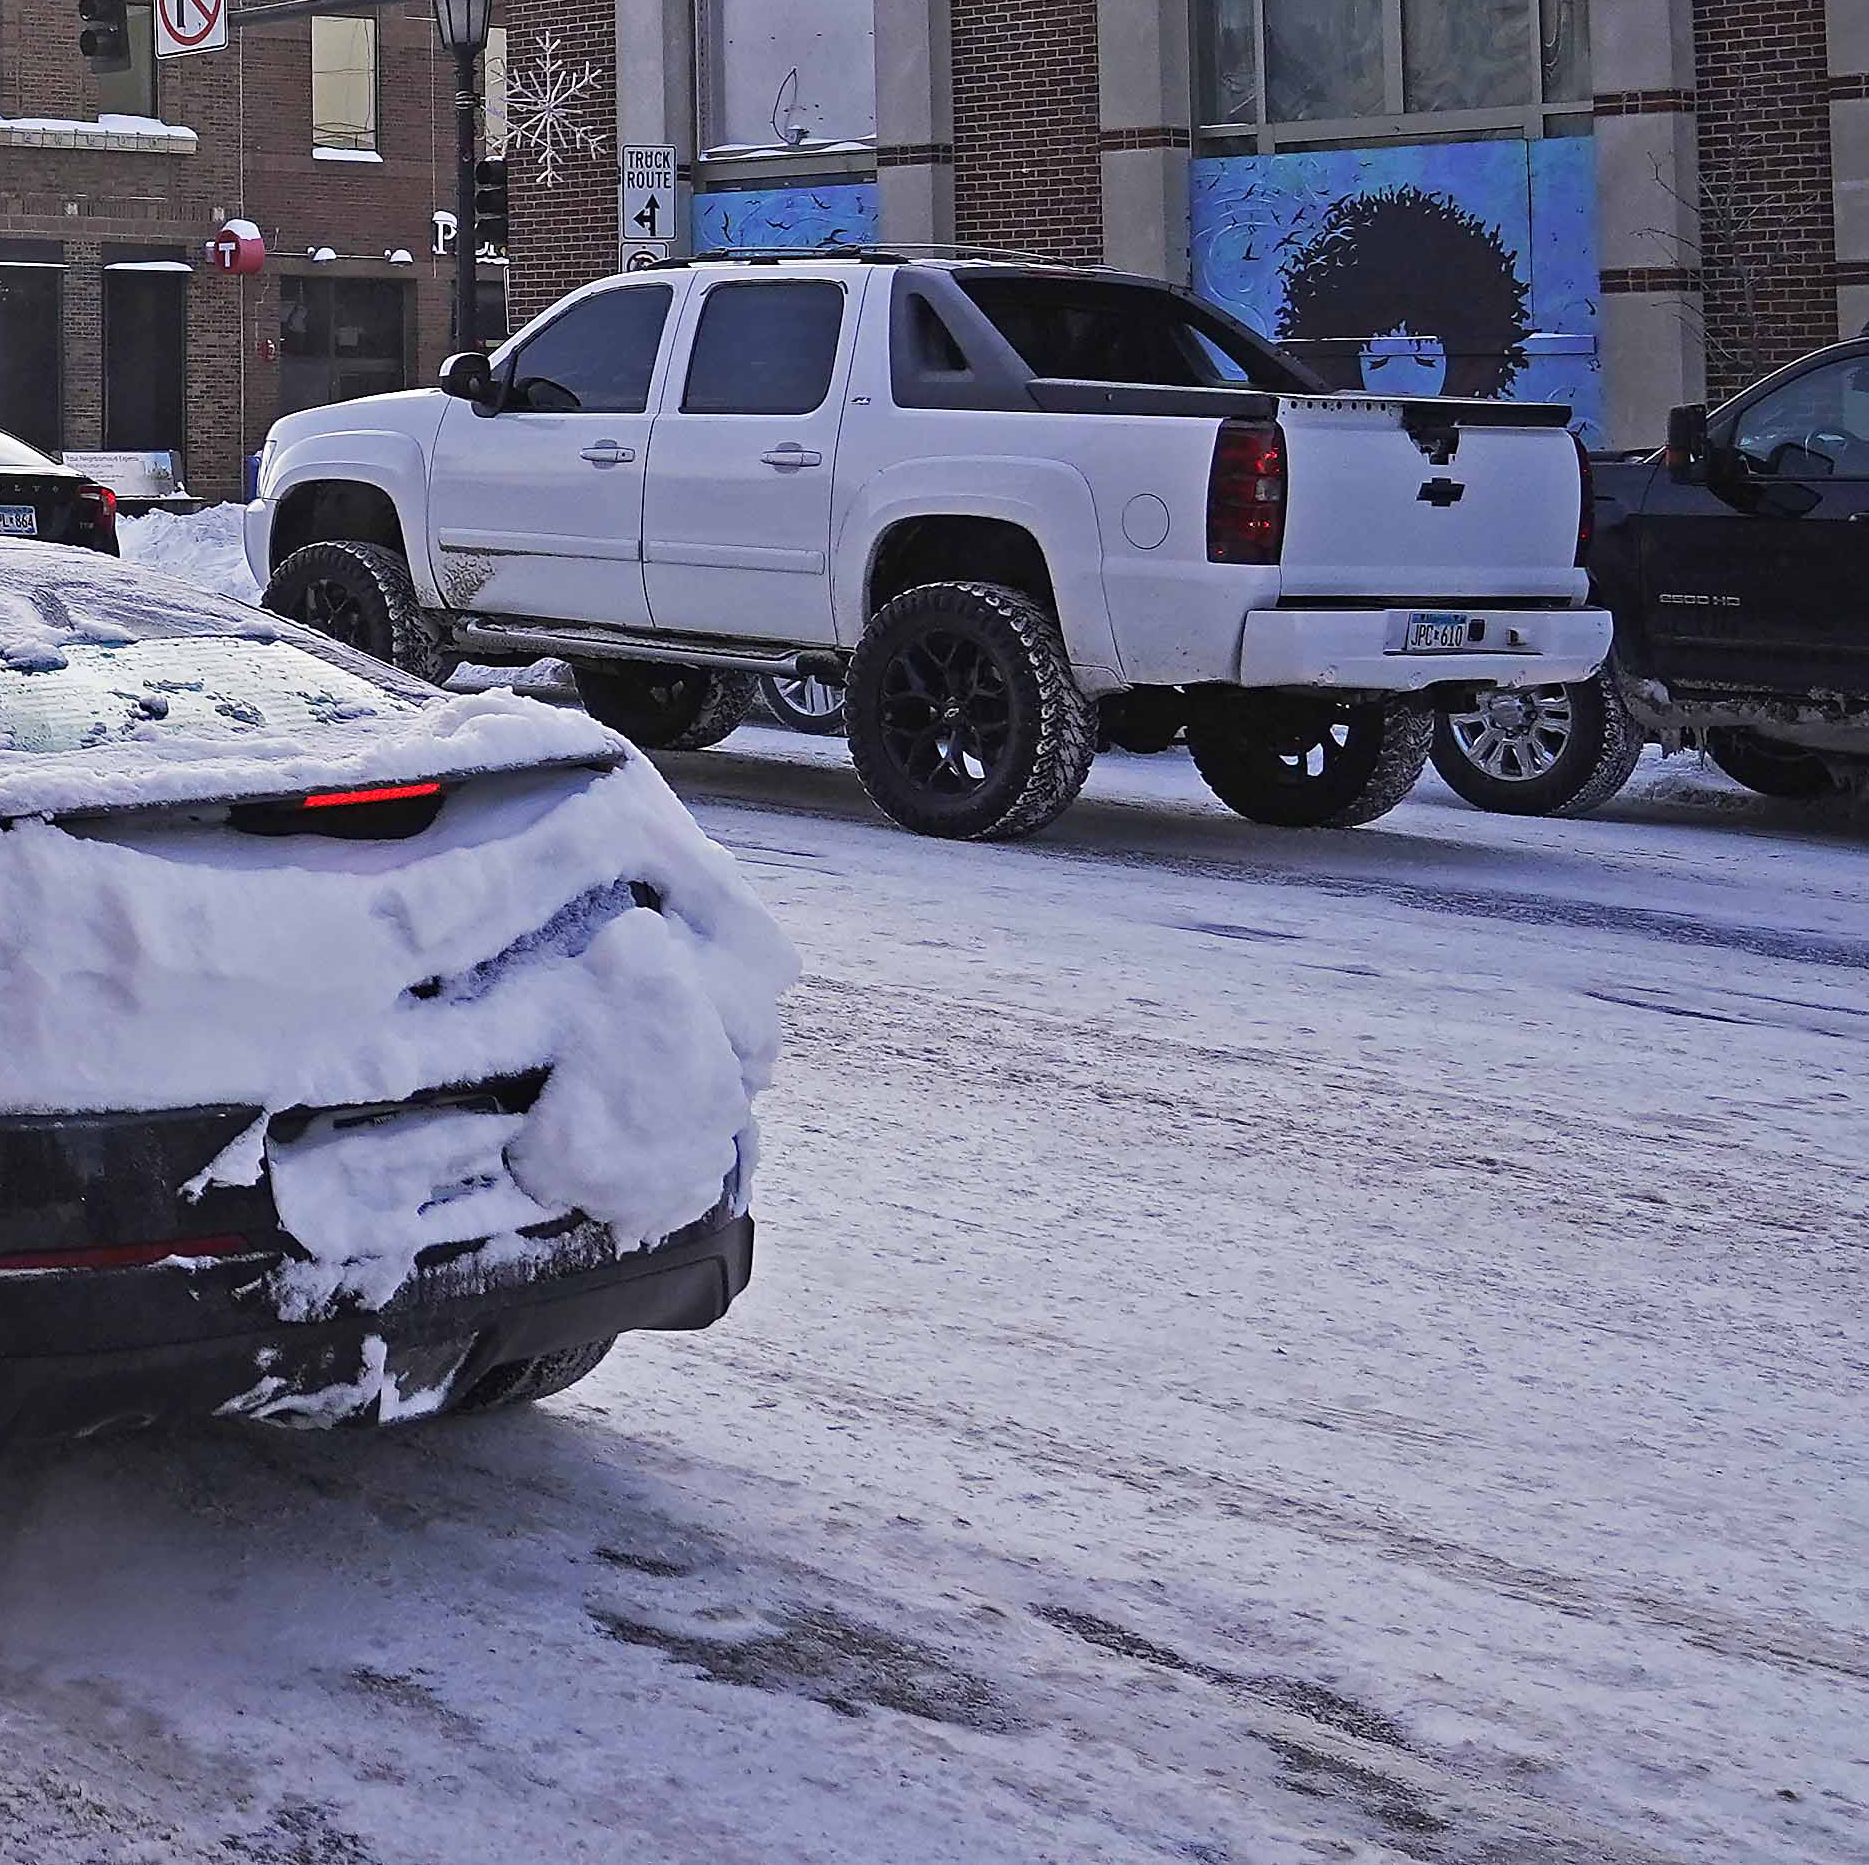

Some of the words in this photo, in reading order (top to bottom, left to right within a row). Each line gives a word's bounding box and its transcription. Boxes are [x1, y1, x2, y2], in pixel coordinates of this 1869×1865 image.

[627, 150, 672, 169] TRUCK
[627, 171, 672, 189] ROUTE
[14, 514, 34, 529] 864
[1410, 624, 1434, 647] JPC
[1440, 625, 1463, 647] 610
